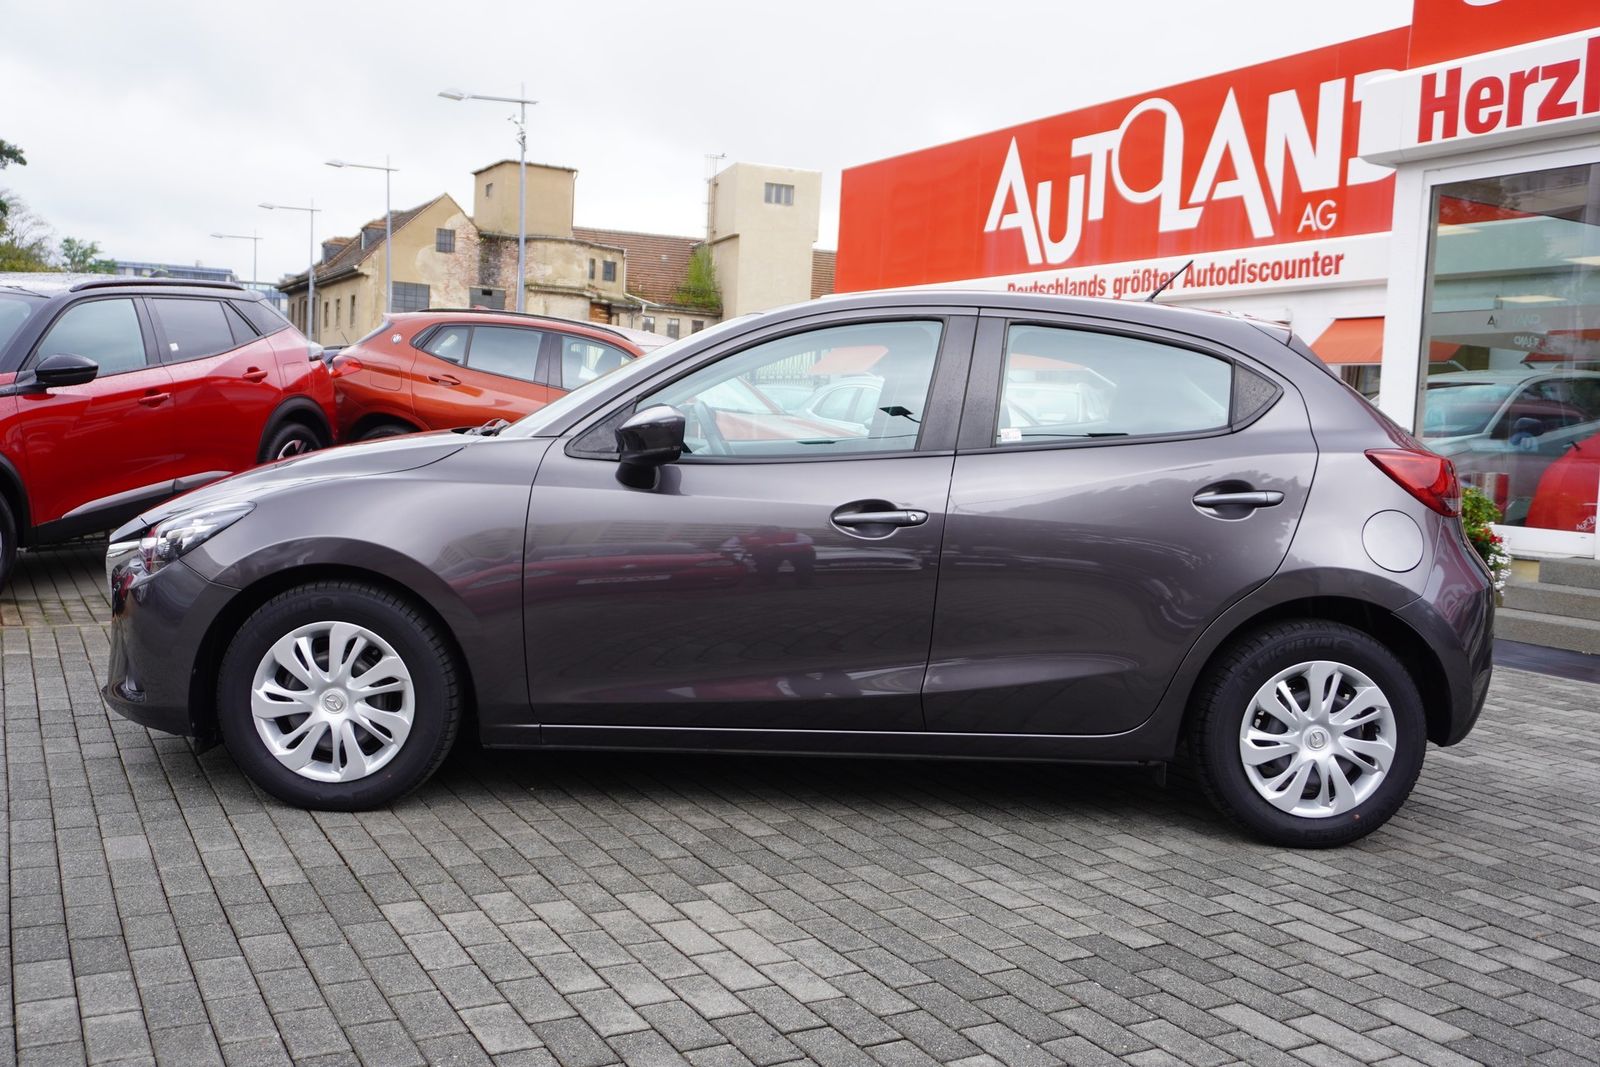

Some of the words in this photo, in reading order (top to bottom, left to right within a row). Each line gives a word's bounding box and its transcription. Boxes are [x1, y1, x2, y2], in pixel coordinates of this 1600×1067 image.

[1297, 199, 1337, 232] AG
[1112, 268, 1176, 299] größter
[1183, 250, 1344, 289] Autodiscounter
